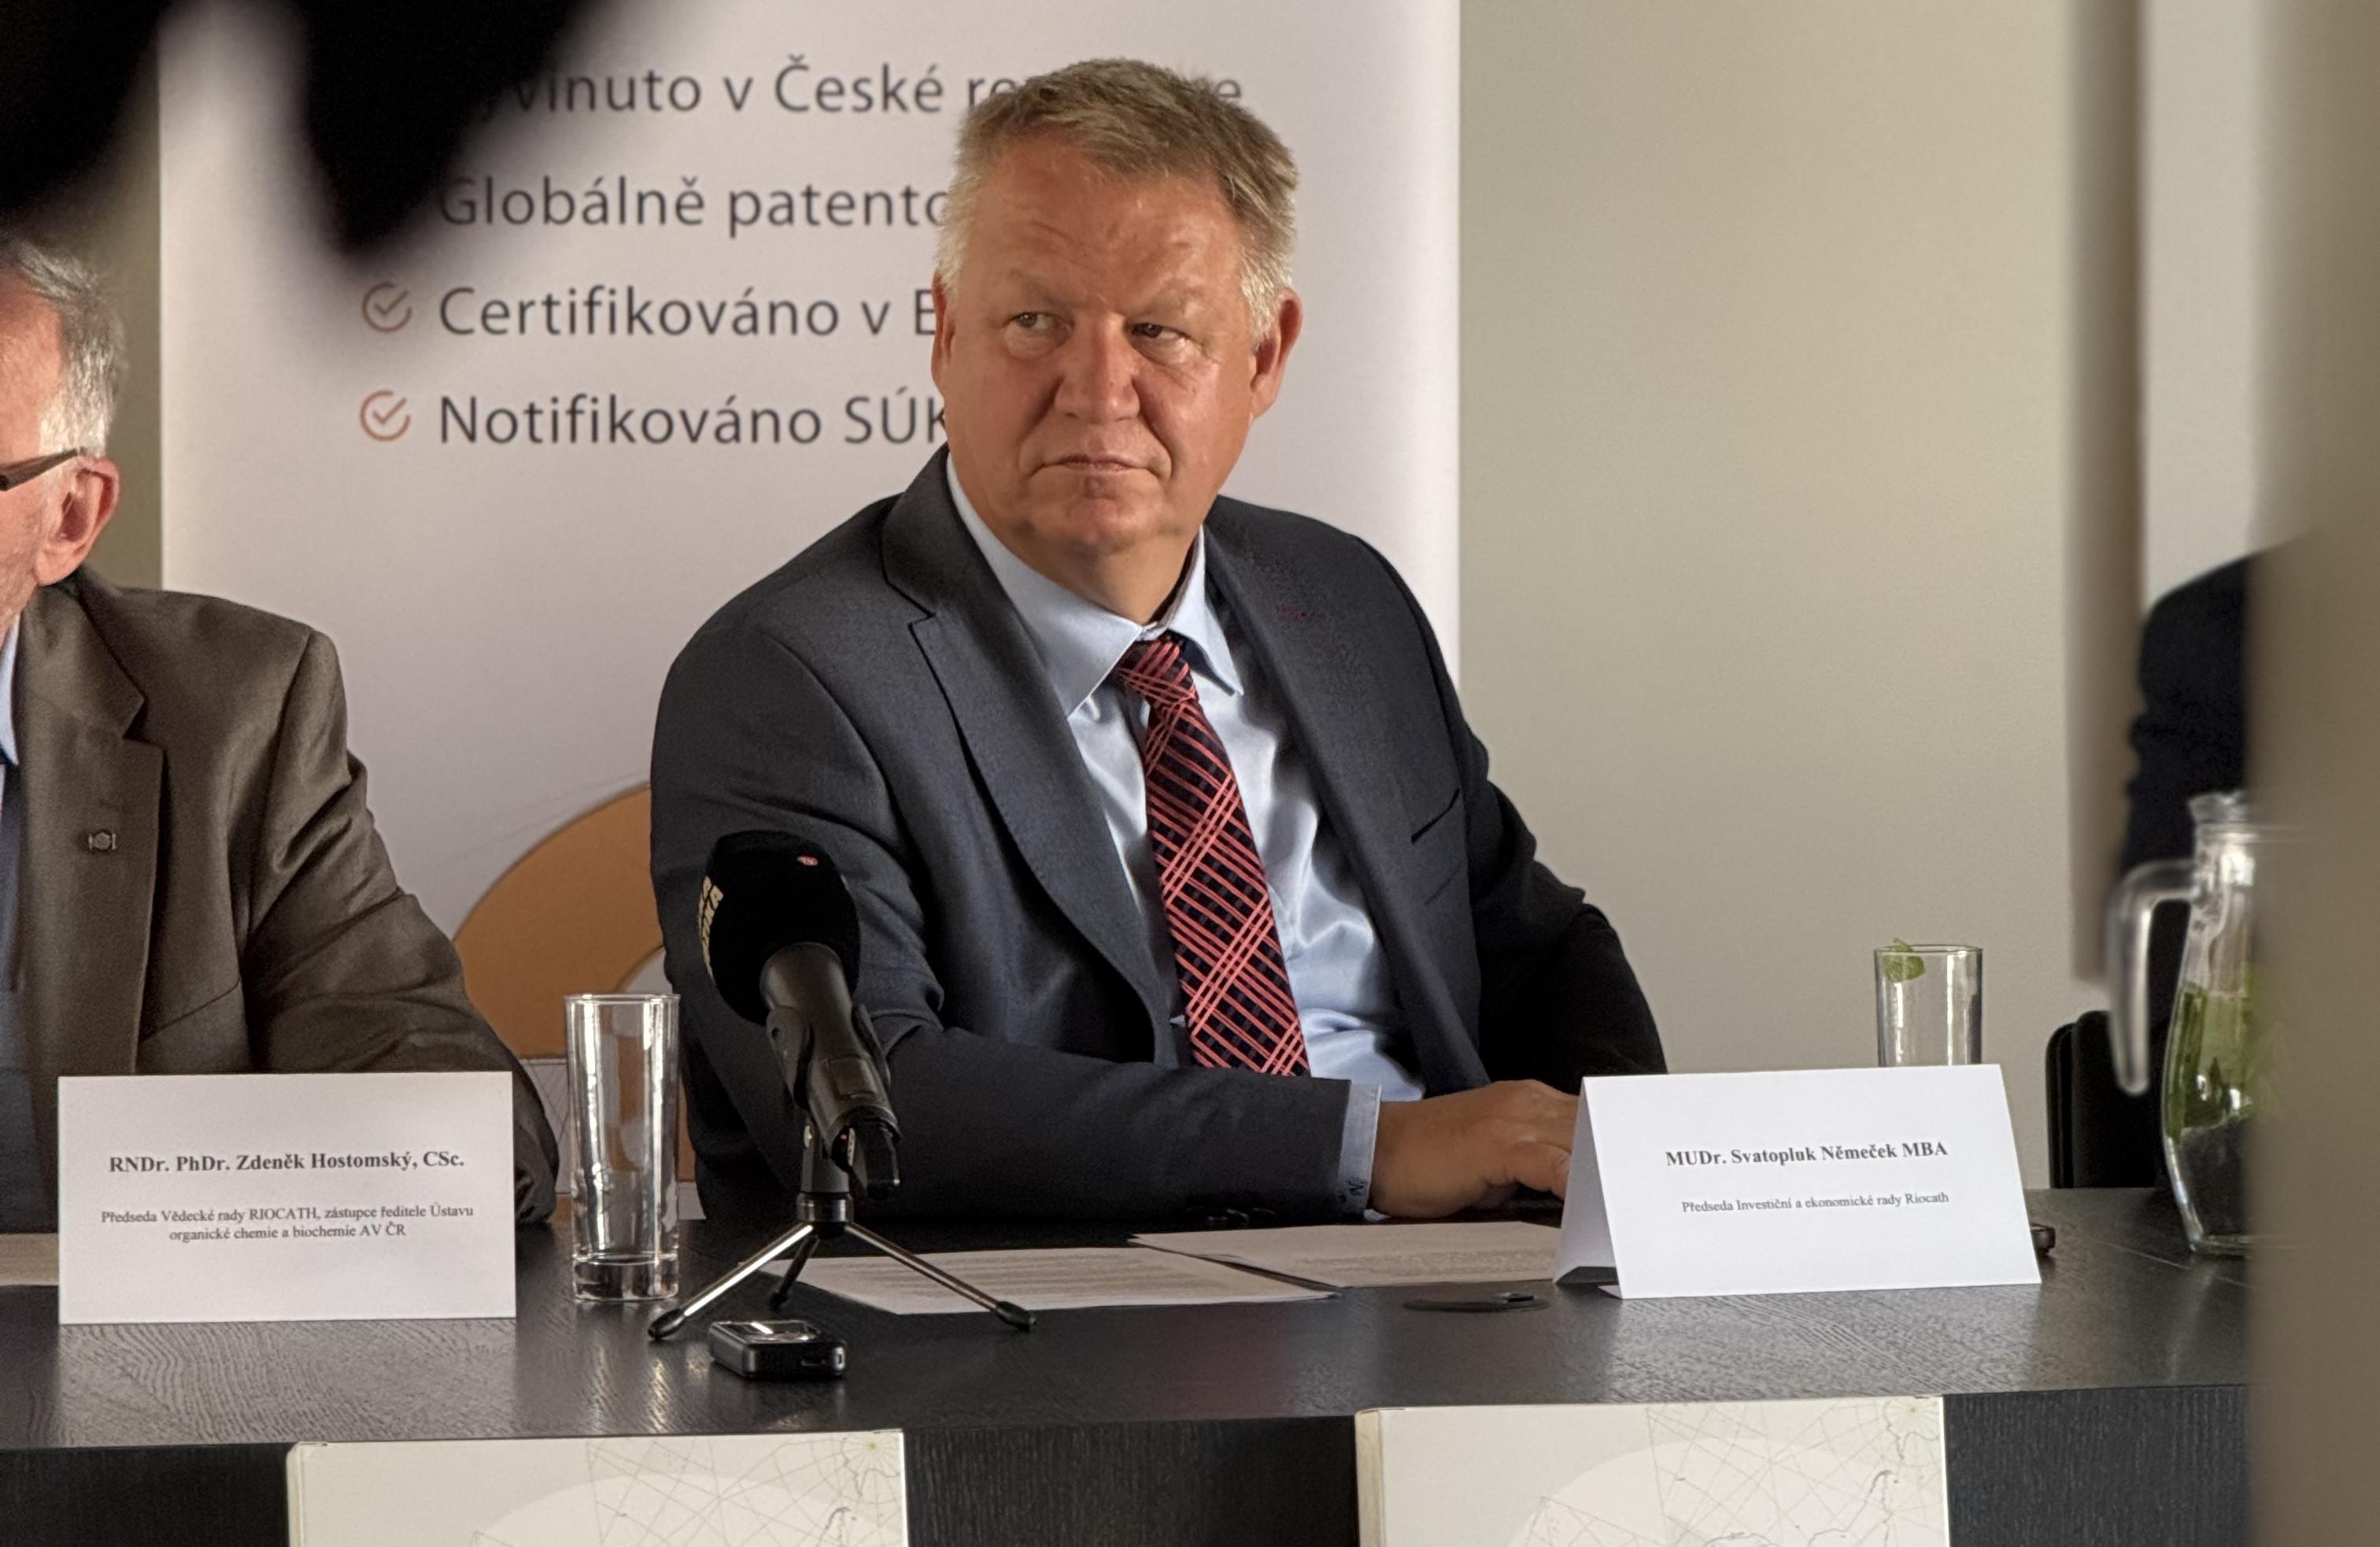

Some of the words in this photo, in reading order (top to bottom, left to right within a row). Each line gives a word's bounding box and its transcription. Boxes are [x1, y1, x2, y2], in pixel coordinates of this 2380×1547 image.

[722, 77, 754, 112] v
[774, 54, 944, 113] České
[440, 175, 705, 227] Globálně
[728, 183, 947, 240] patento
[438, 285, 840, 336] Certifikováno
[861, 301, 891, 336] v
[915, 288, 936, 335] E
[440, 394, 822, 445] Notifikováno
[844, 386, 947, 445] SÚK
[109, 1155, 170, 1173] RNDr.
[176, 1155, 231, 1172] PhDr.
[236, 1153, 305, 1171] Zdeněk
[311, 1151, 418, 1171] Hostomský,
[422, 1150, 465, 1168] CSc.
[1665, 1149, 1727, 1167] MUDr.
[1731, 1146, 1817, 1166] Svatopluk
[1820, 1143, 1898, 1161] Němeček
[1901, 1141, 1949, 1158] MBA
[100, 1209, 157, 1224] Předseda
[160, 1208, 215, 1223] Vědecké
[216, 1208, 246, 1223] rady
[323, 1205, 378, 1223] zástupce
[379, 1204, 427, 1219] ředitele
[429, 1201, 474, 1218] Ústavu
[1681, 1199, 1734, 1213] Předseda
[1736, 1197, 1793, 1211] Investiční
[1794, 1200, 1803, 1209] a
[1804, 1194, 1875, 1208] ekonomické
[1876, 1194, 1902, 1208] rady
[1904, 1191, 1949, 1205] Riocath
[168, 1226, 231, 1242] organické
[233, 1225, 279, 1240] chemie
[281, 1228, 290, 1238] a
[292, 1223, 357, 1238] biochemie
[358, 1223, 382, 1237] AV
[384, 1220, 407, 1237] ČR
